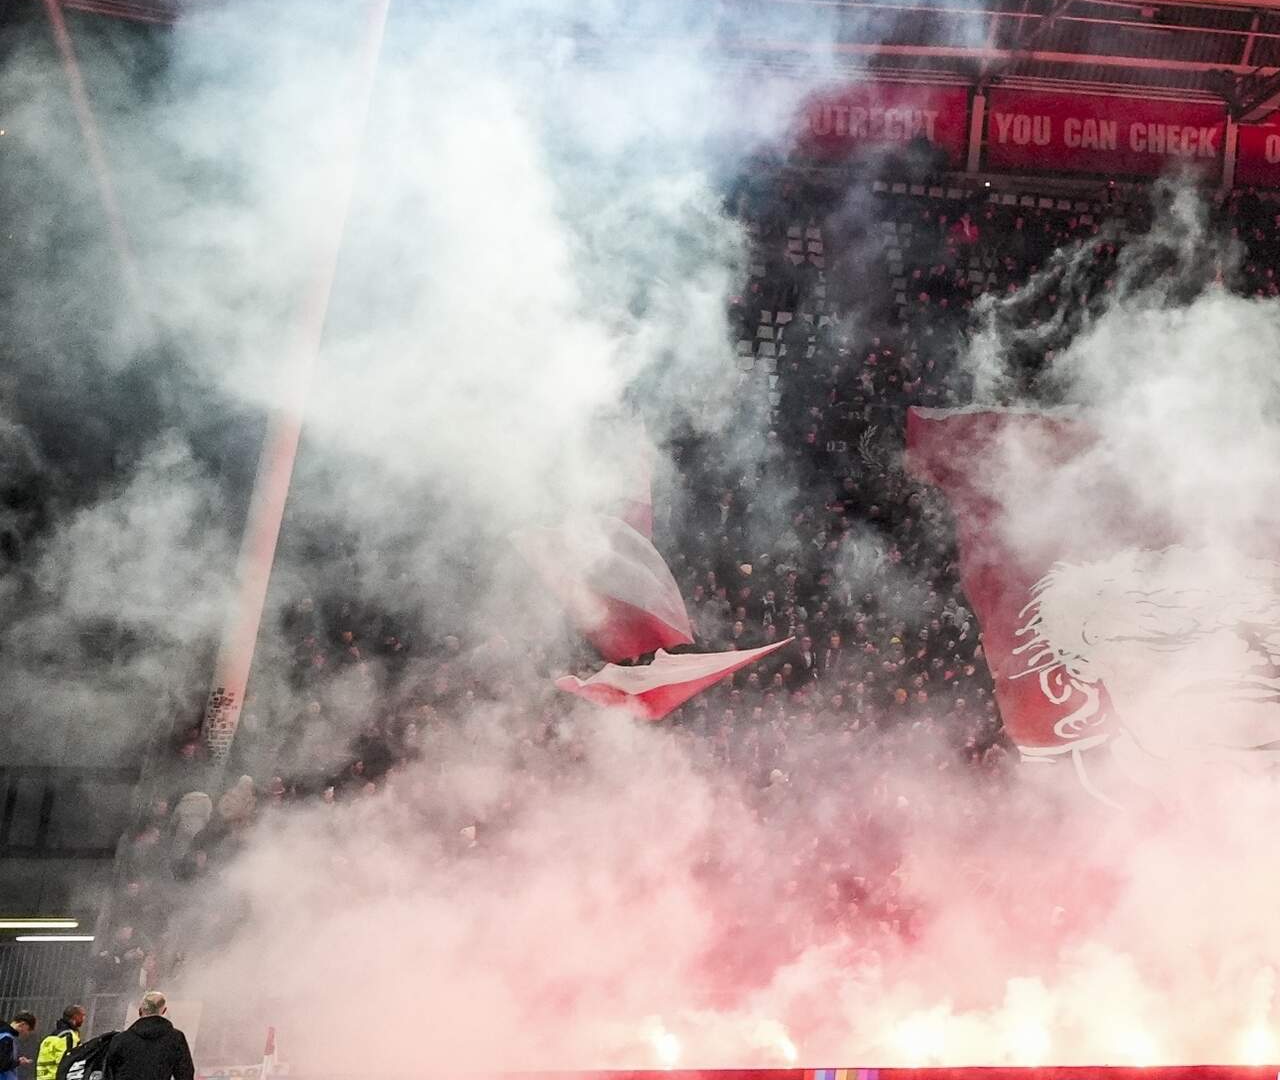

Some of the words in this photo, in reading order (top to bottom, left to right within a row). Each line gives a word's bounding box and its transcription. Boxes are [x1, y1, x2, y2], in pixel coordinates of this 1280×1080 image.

[996, 113, 1050, 146] YOU
[1063, 118, 1118, 151] CAN
[1130, 122, 1218, 158] CHECK
